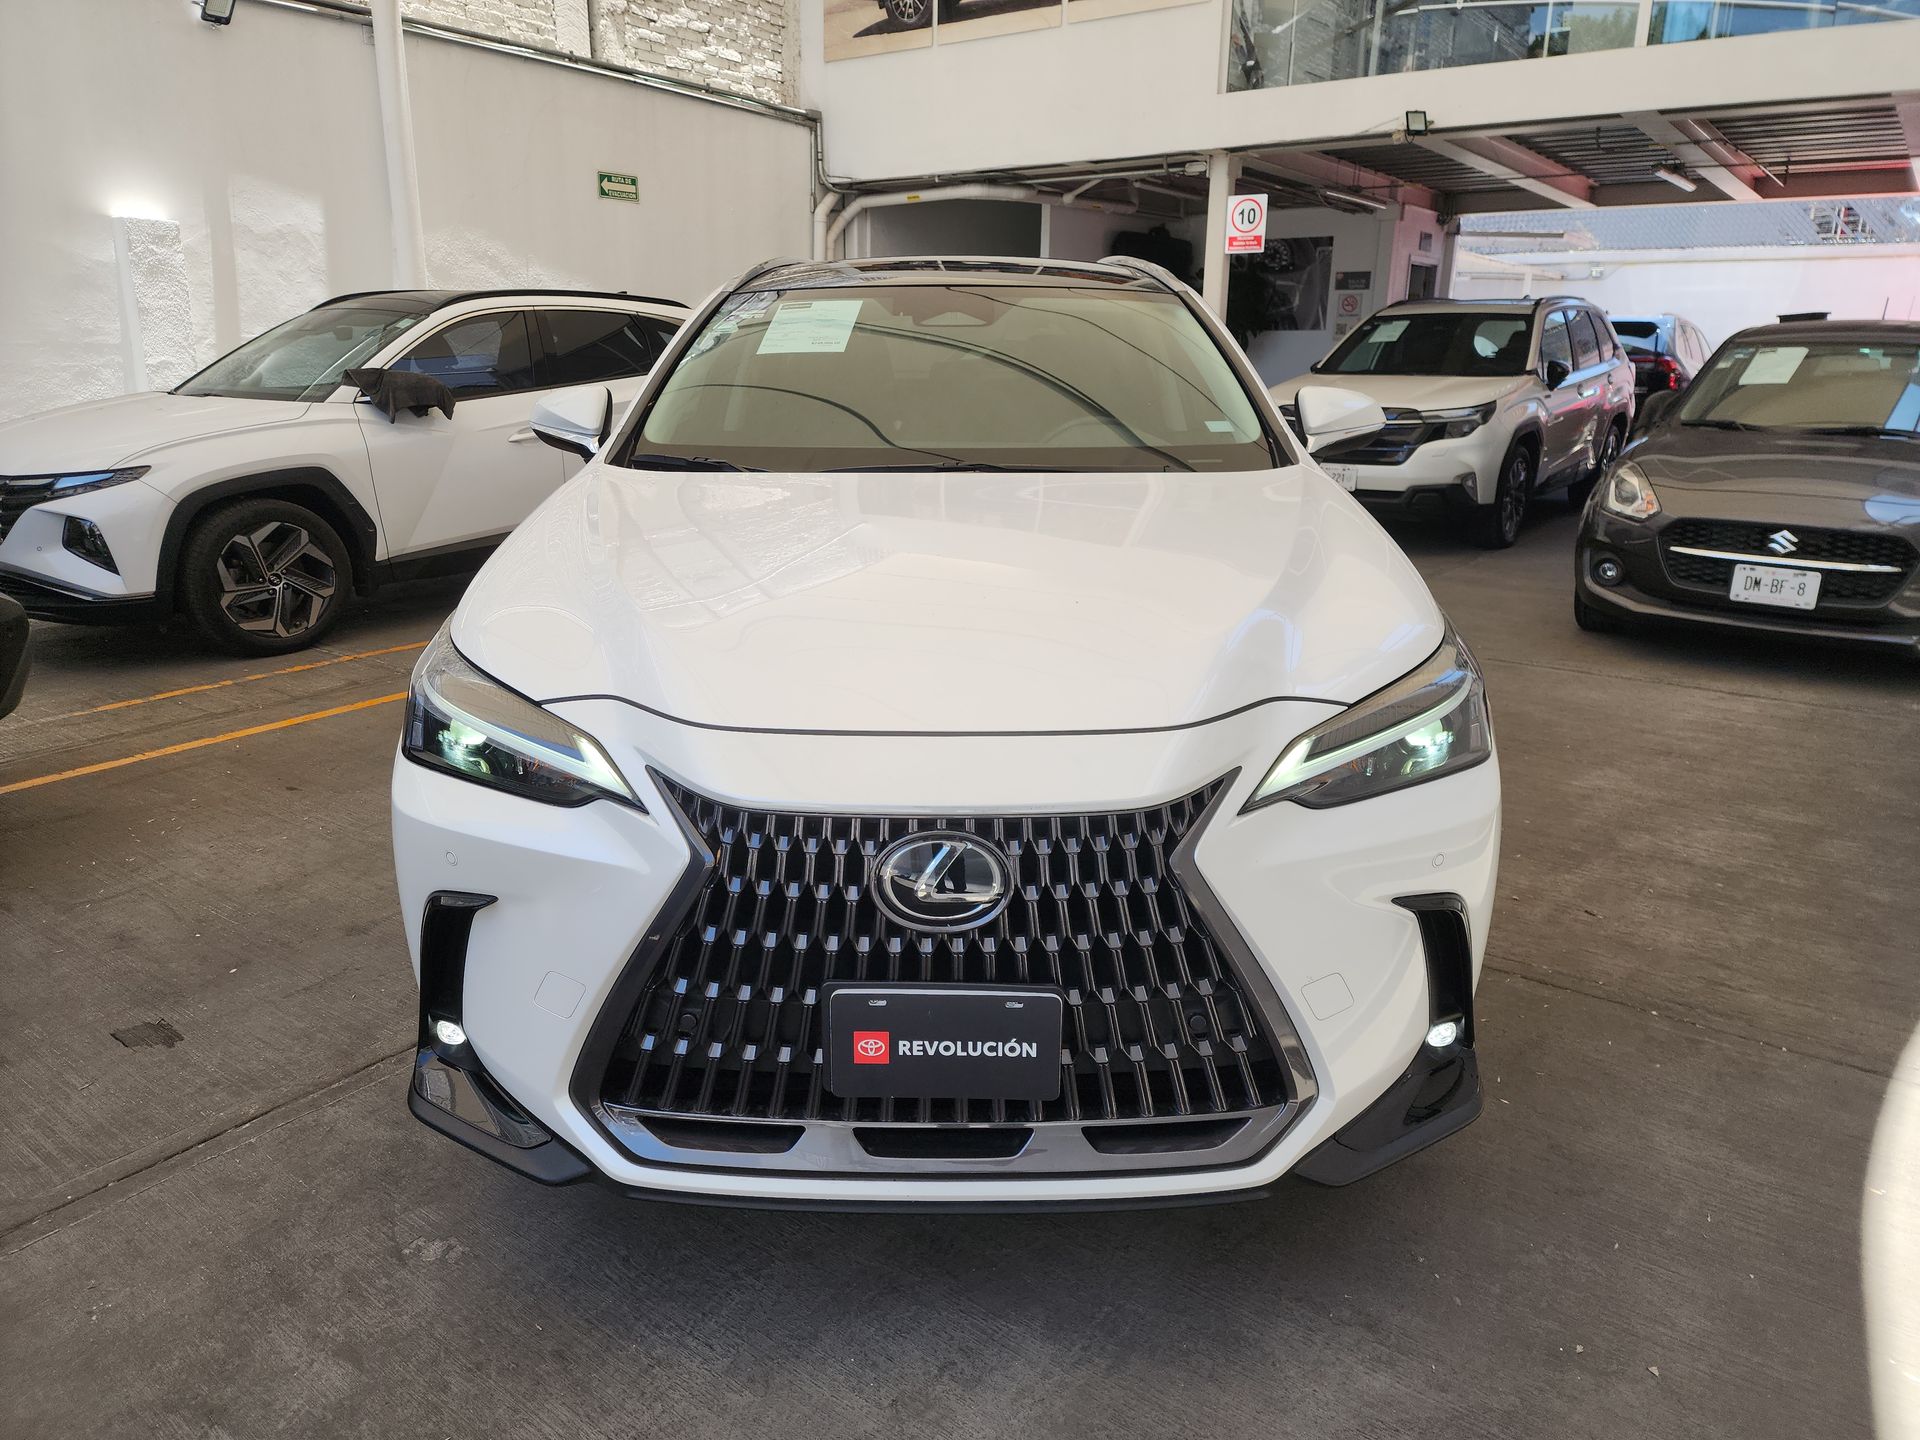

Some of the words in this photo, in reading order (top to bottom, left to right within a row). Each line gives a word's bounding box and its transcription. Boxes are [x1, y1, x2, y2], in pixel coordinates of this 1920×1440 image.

[611, 176, 625, 184] RUTA
[1239, 208, 1256, 225] 10
[898, 1038, 1037, 1058] REVOLUCIÓN
